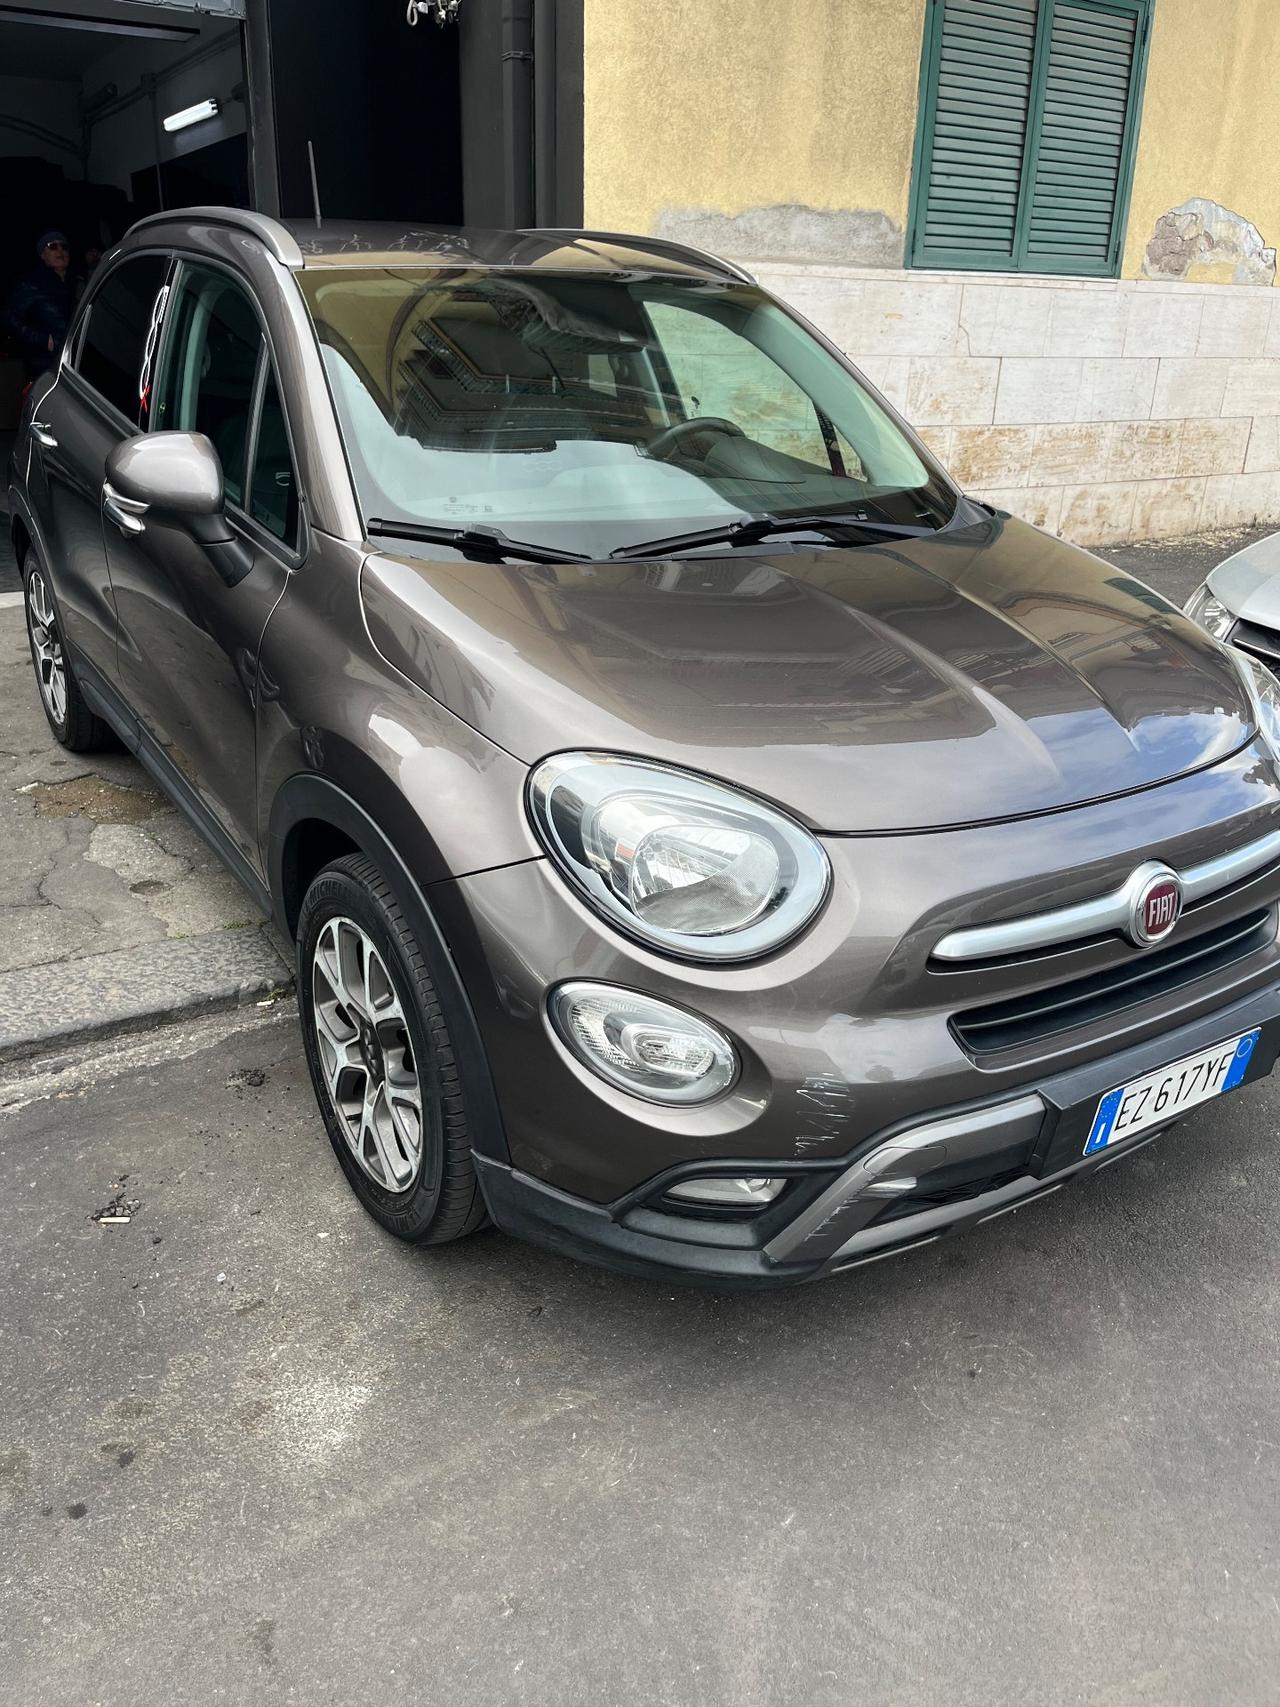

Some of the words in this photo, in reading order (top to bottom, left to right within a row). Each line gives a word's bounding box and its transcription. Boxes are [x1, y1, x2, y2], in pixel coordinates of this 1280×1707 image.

[1148, 892, 1175, 927] FIAT
[1114, 1086, 1153, 1131] EZ
[1153, 1051, 1235, 1113] 617YF
[1095, 1122, 1107, 1144] I
